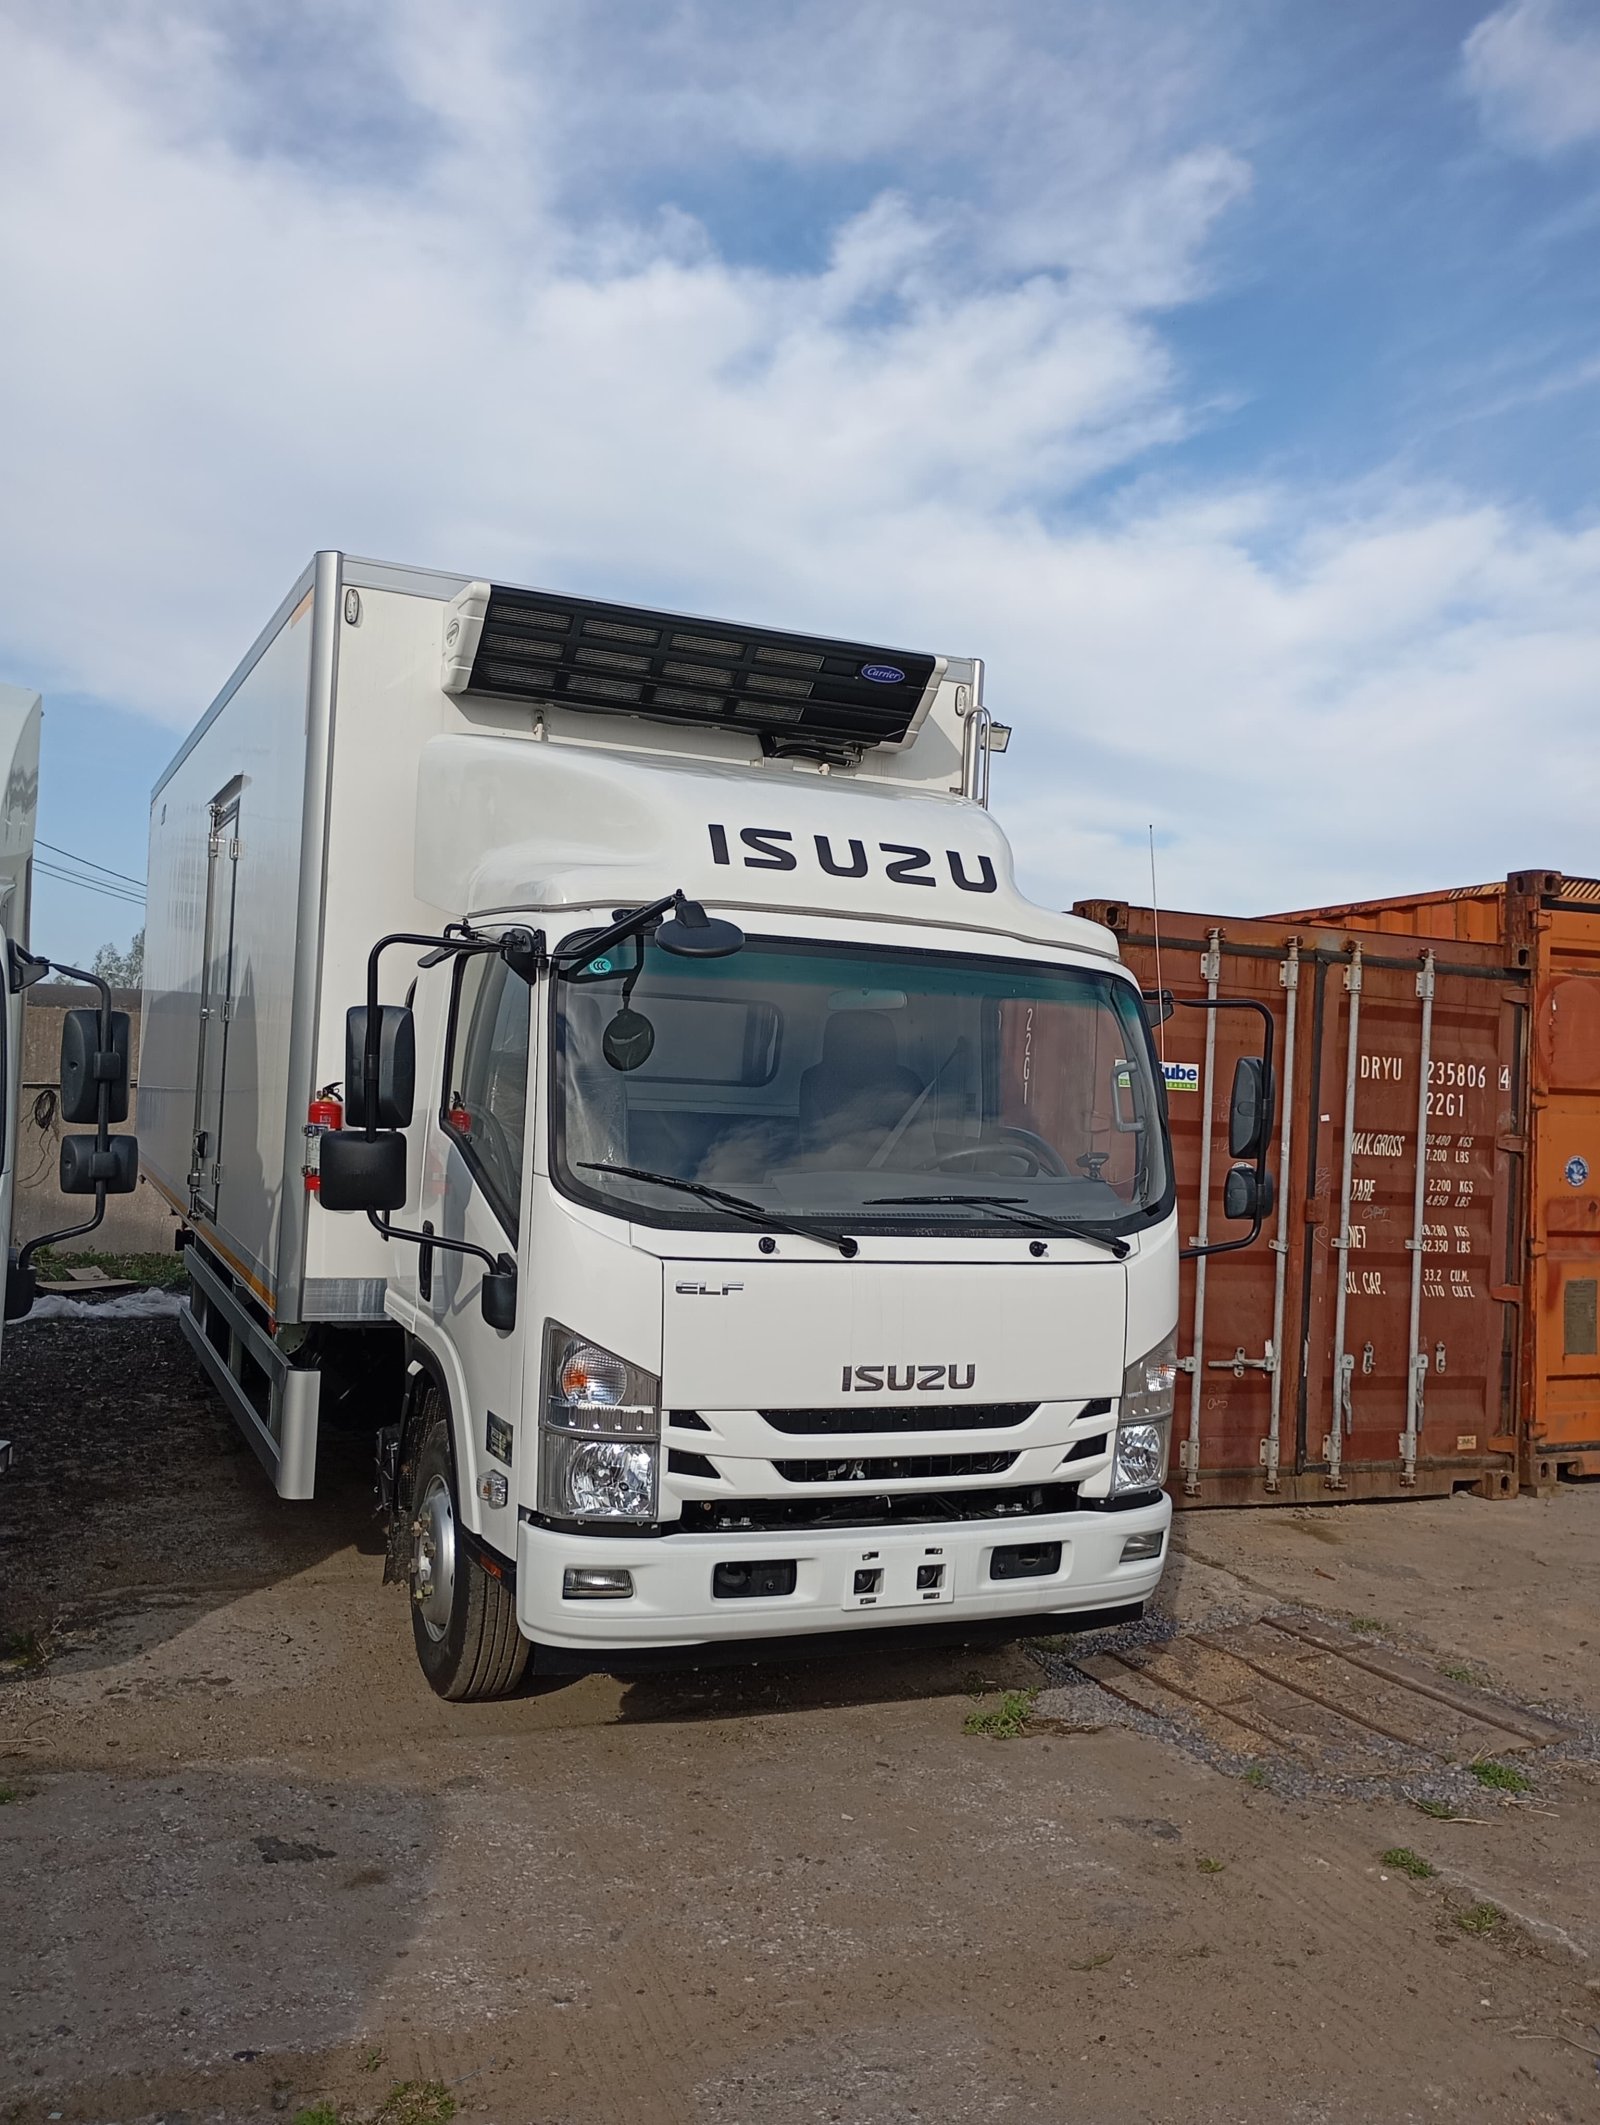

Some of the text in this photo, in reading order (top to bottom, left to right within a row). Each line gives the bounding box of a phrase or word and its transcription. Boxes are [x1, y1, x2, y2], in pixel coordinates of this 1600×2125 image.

[867, 667, 900, 679] Carrier
[708, 824, 997, 893] ISUZU
[1360, 1055, 1509, 1089] DRYU 235806 4
[1426, 1092, 1464, 1117] 22G1
[1457, 1136, 1474, 1148] KGS
[1425, 1148, 1470, 1163] 7.200 LBS
[1350, 1179, 1474, 1201] TARE 2.200 KGS
[1425, 1194, 1472, 1207] 4.850 LBS
[1348, 1225, 1366, 1249] NET
[1453, 1225, 1470, 1237] KGS
[1422, 1239, 1471, 1253] 62.350 LBS
[675, 1280, 744, 1296] ELF
[1362, 1271, 1386, 1295] CAP.
[1424, 1269, 1442, 1282] 33.2
[841, 1363, 976, 1392] ISUZU
